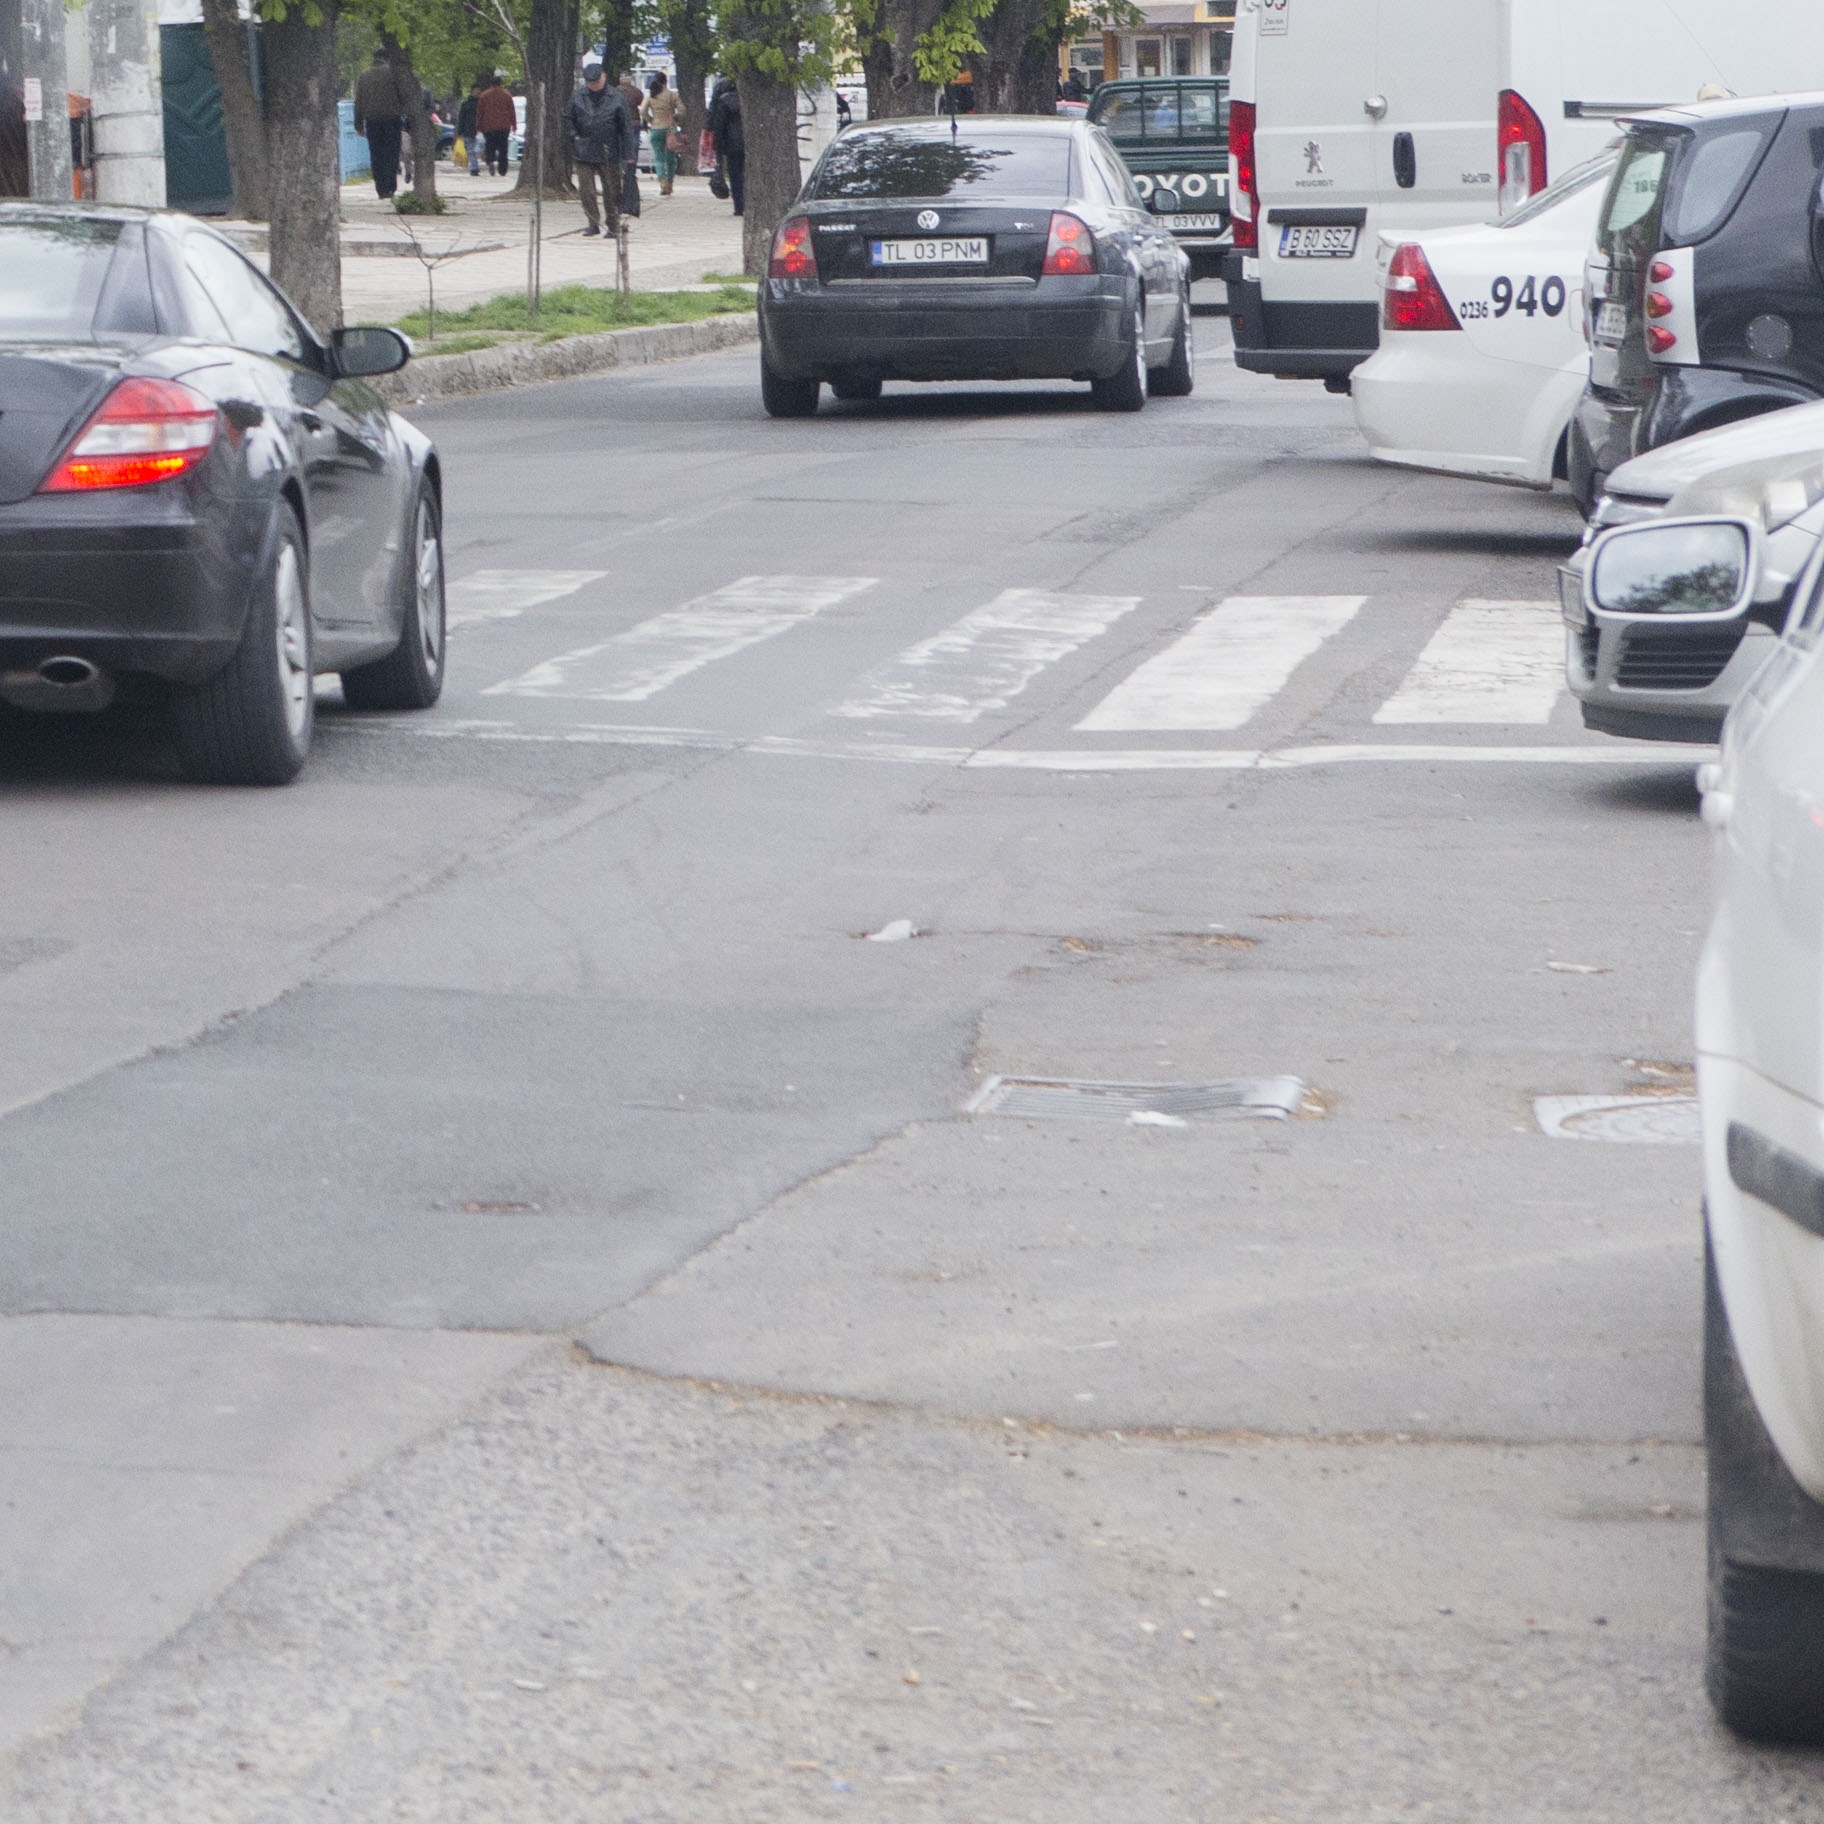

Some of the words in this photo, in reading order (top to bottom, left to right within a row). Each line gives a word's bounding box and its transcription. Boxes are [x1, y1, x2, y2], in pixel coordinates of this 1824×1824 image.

[1133, 173, 1229, 197] OYOT
[1291, 228, 1302, 249] B
[1303, 228, 1320, 248] 60
[1322, 228, 1353, 249] SSZ
[884, 243, 906, 261] TL
[914, 241, 936, 260] 03
[941, 240, 983, 260] PNM
[1460, 301, 1489, 319] 0236
[1491, 275, 1566, 318] 940
